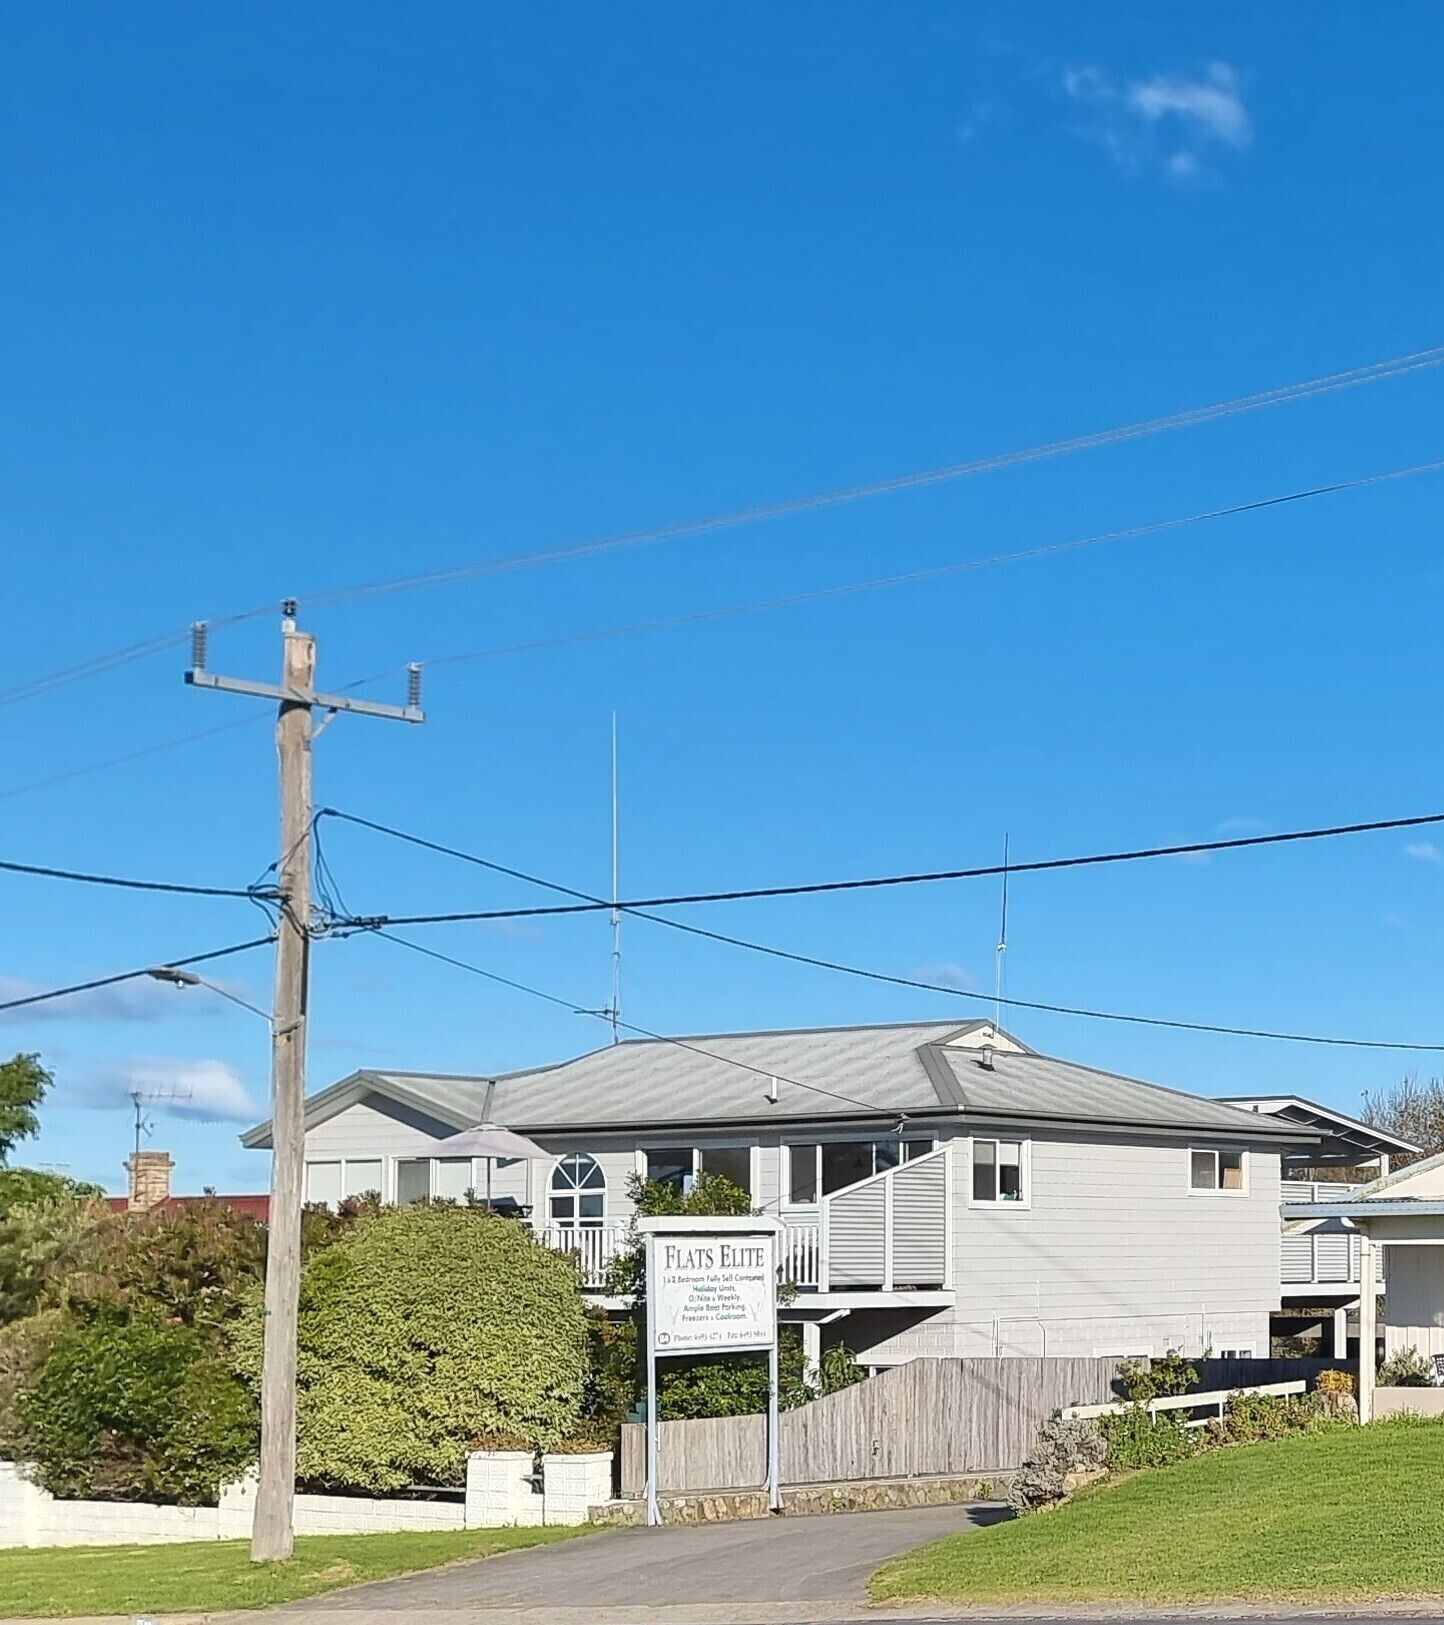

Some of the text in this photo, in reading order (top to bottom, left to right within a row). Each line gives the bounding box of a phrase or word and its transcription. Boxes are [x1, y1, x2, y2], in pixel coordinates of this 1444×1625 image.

[664, 1244, 765, 1269] FLATS ELITE
[678, 1275, 705, 1283] Bedroom
[722, 1274, 734, 1282] Self
[693, 1285, 718, 1294] Holiday
[683, 1304, 704, 1313] Ample
[682, 1314, 709, 1322] Freezers
